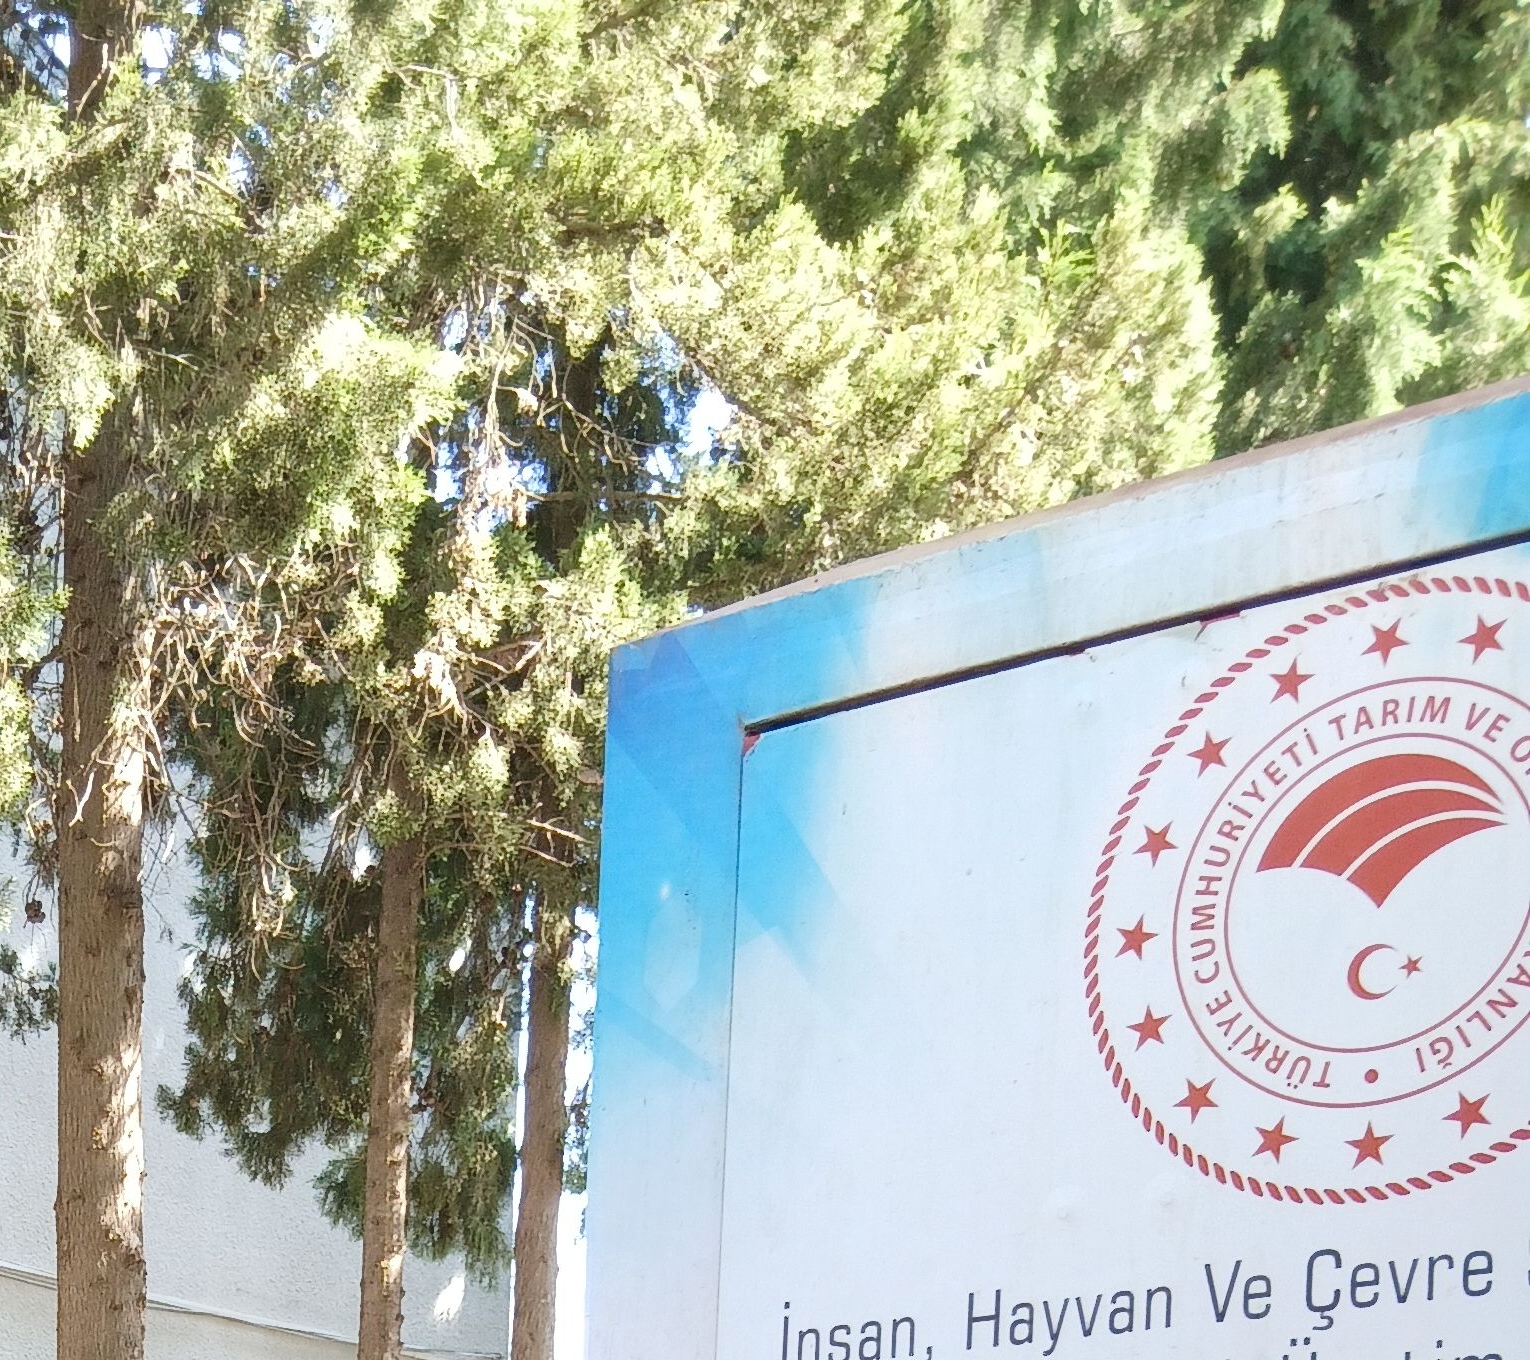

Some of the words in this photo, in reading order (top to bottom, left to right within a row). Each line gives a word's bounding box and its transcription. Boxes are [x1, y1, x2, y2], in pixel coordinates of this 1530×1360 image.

[1328, 696, 1452, 740] TARIM
[1465, 703, 1511, 742] VE
[1190, 728, 1319, 984] CUMHURİYETİ
[1206, 990, 1331, 1089] TÜRKİYE
[966, 1287, 1173, 1357] Hayvan
[1205, 1260, 1272, 1323] Ve
[1306, 1248, 1494, 1330] Çevre
